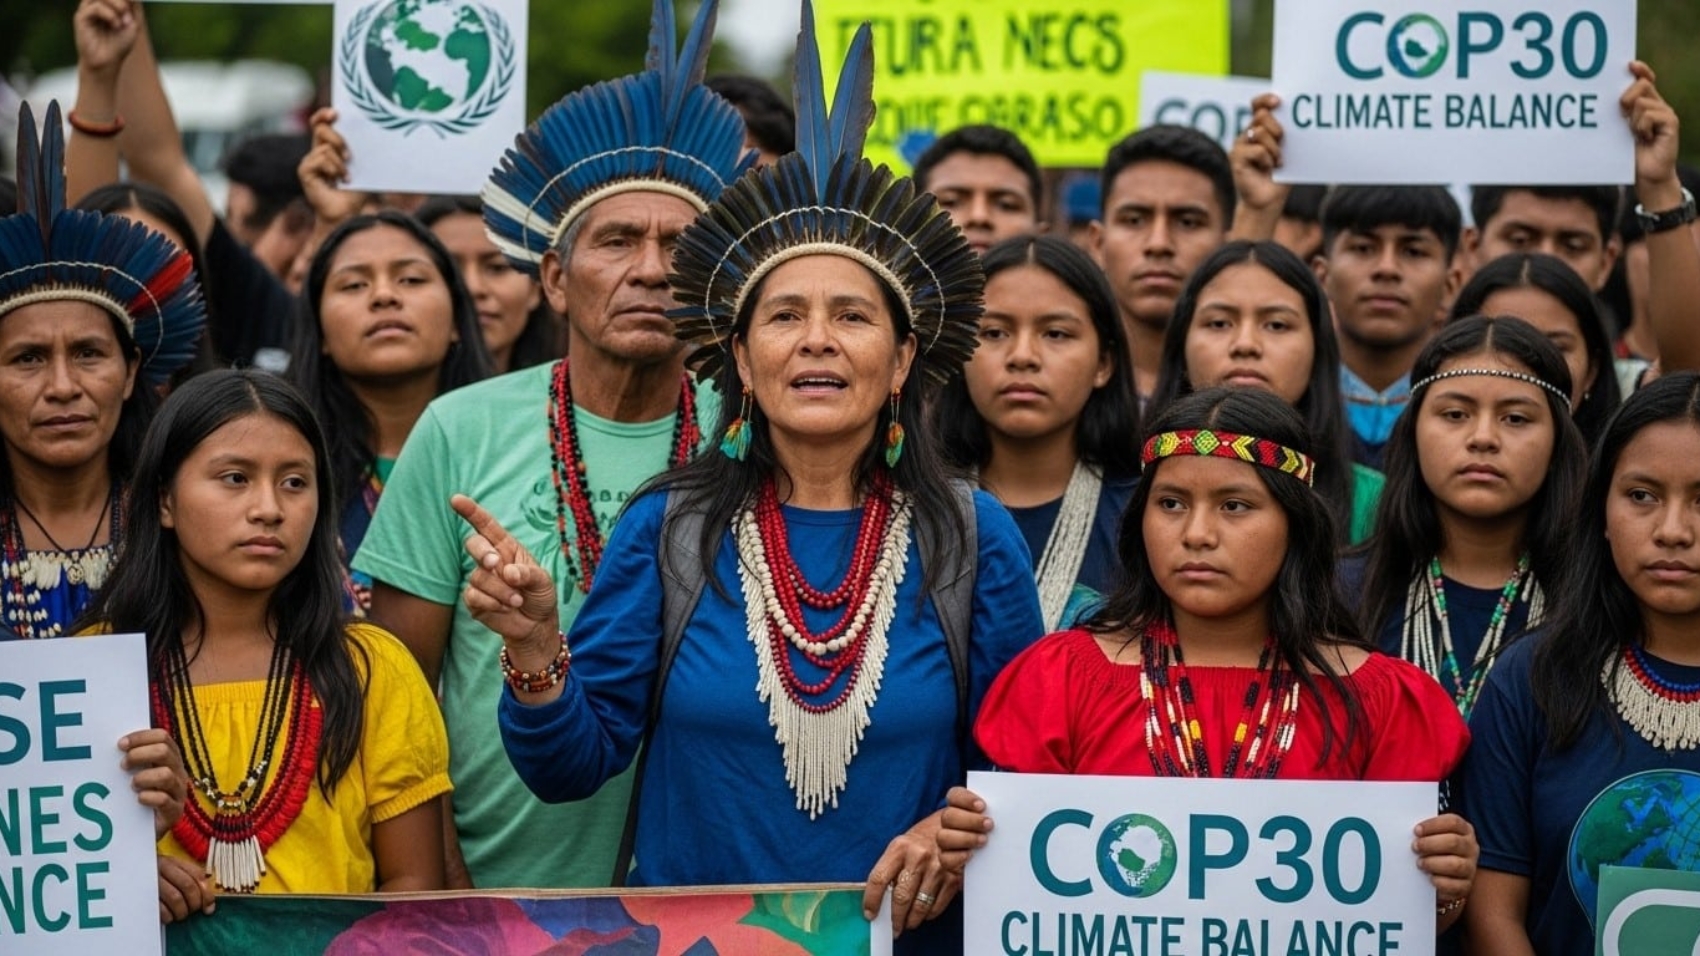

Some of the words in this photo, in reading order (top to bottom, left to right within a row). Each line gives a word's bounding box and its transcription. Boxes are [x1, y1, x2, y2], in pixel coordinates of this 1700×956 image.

[1335, 11, 1609, 80] COP30
[1292, 94, 1432, 129] CLIMATE
[1445, 94, 1598, 129] BALANCE
[1029, 808, 1382, 905] COP30
[1001, 910, 1185, 956] CLIMATE
[1201, 918, 1403, 956] BALANCE
